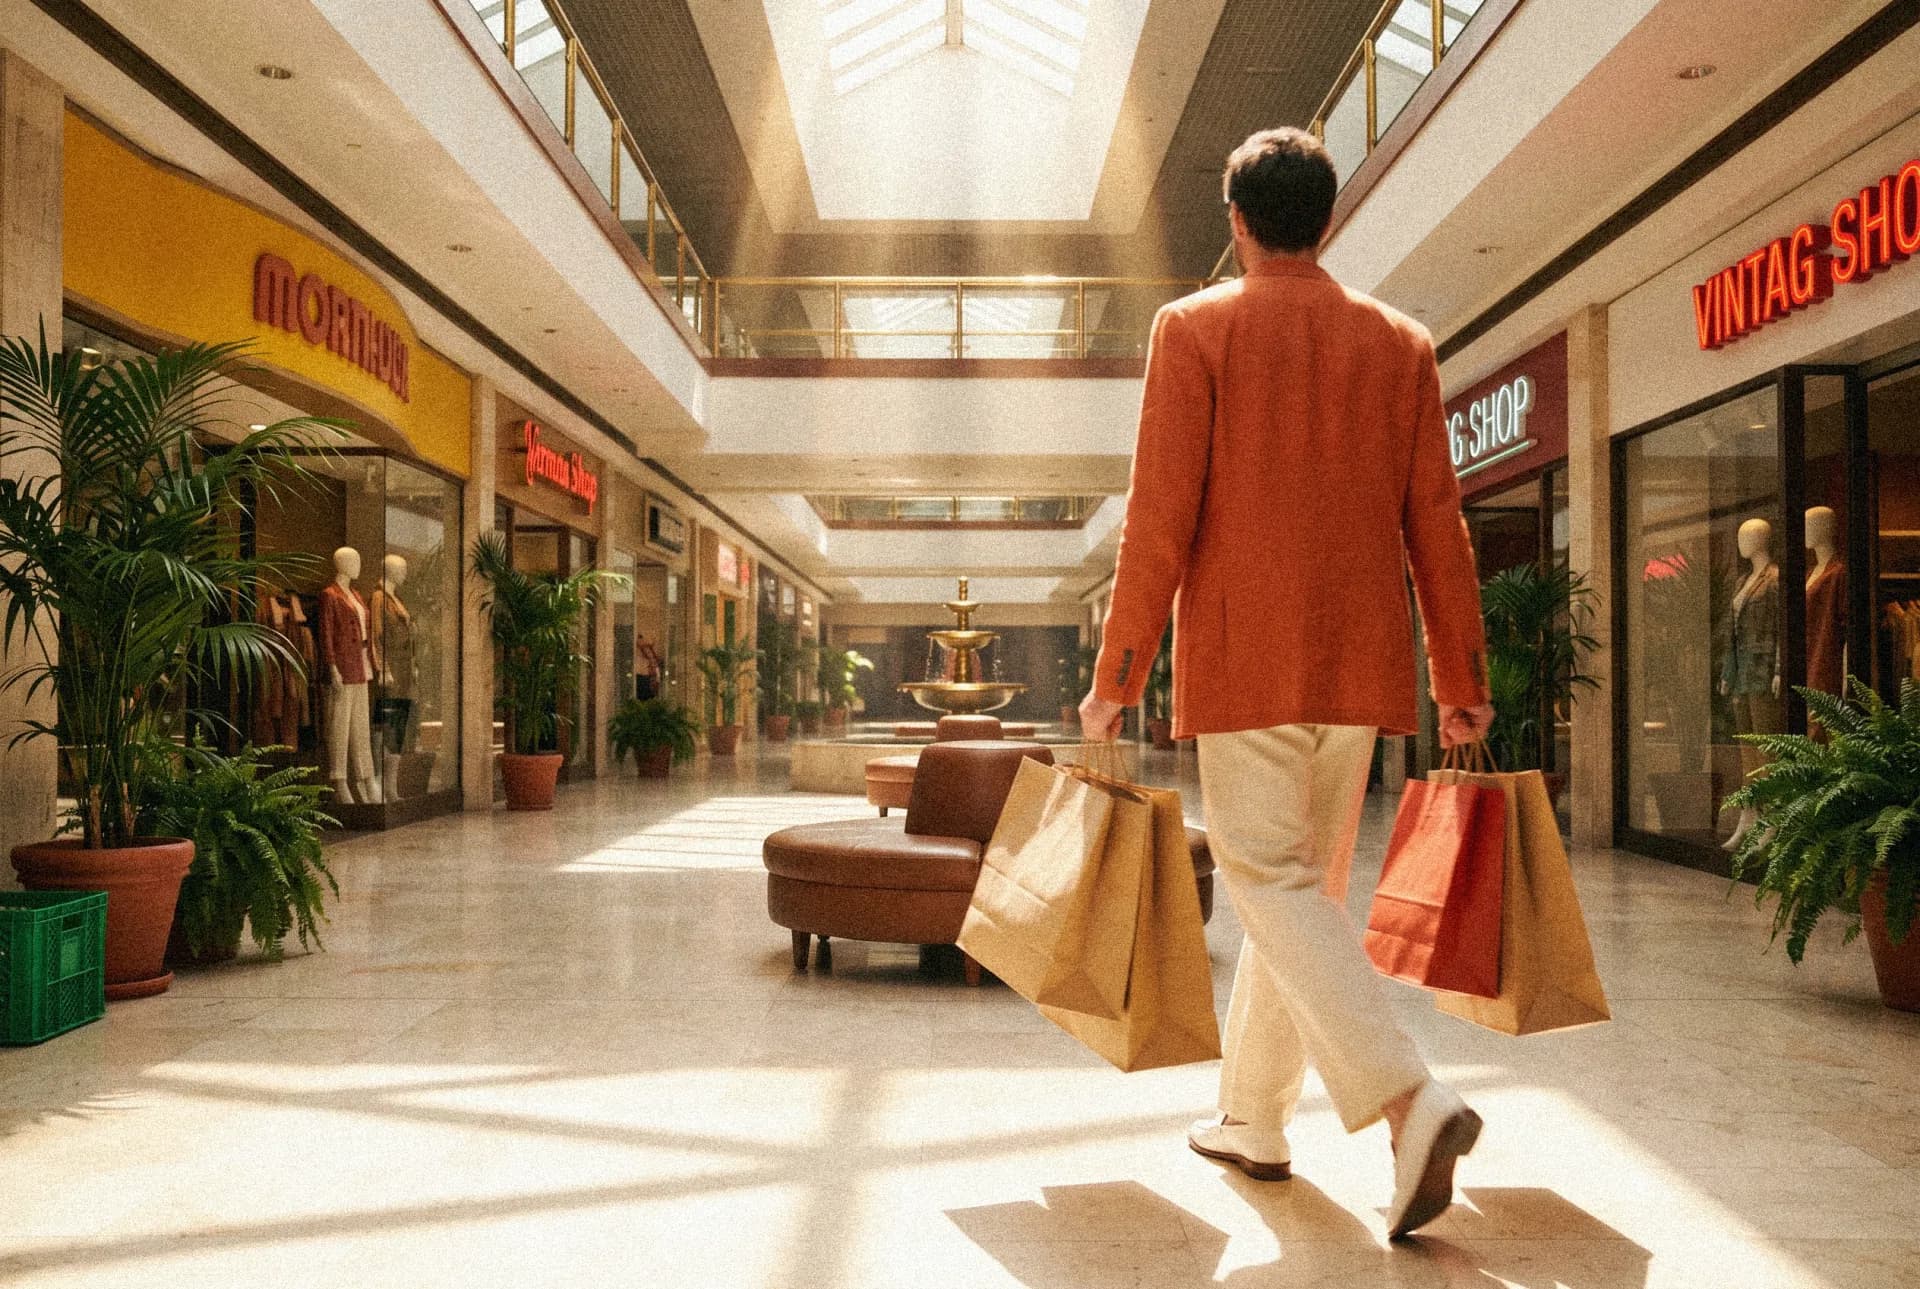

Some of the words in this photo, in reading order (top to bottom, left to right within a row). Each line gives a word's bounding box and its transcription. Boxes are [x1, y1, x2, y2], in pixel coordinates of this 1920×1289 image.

[1692, 223, 1818, 350] VINTAG
[1830, 158, 1920, 285] SHO
[1445, 410, 1466, 467] G
[1468, 375, 1532, 458] SHOP
